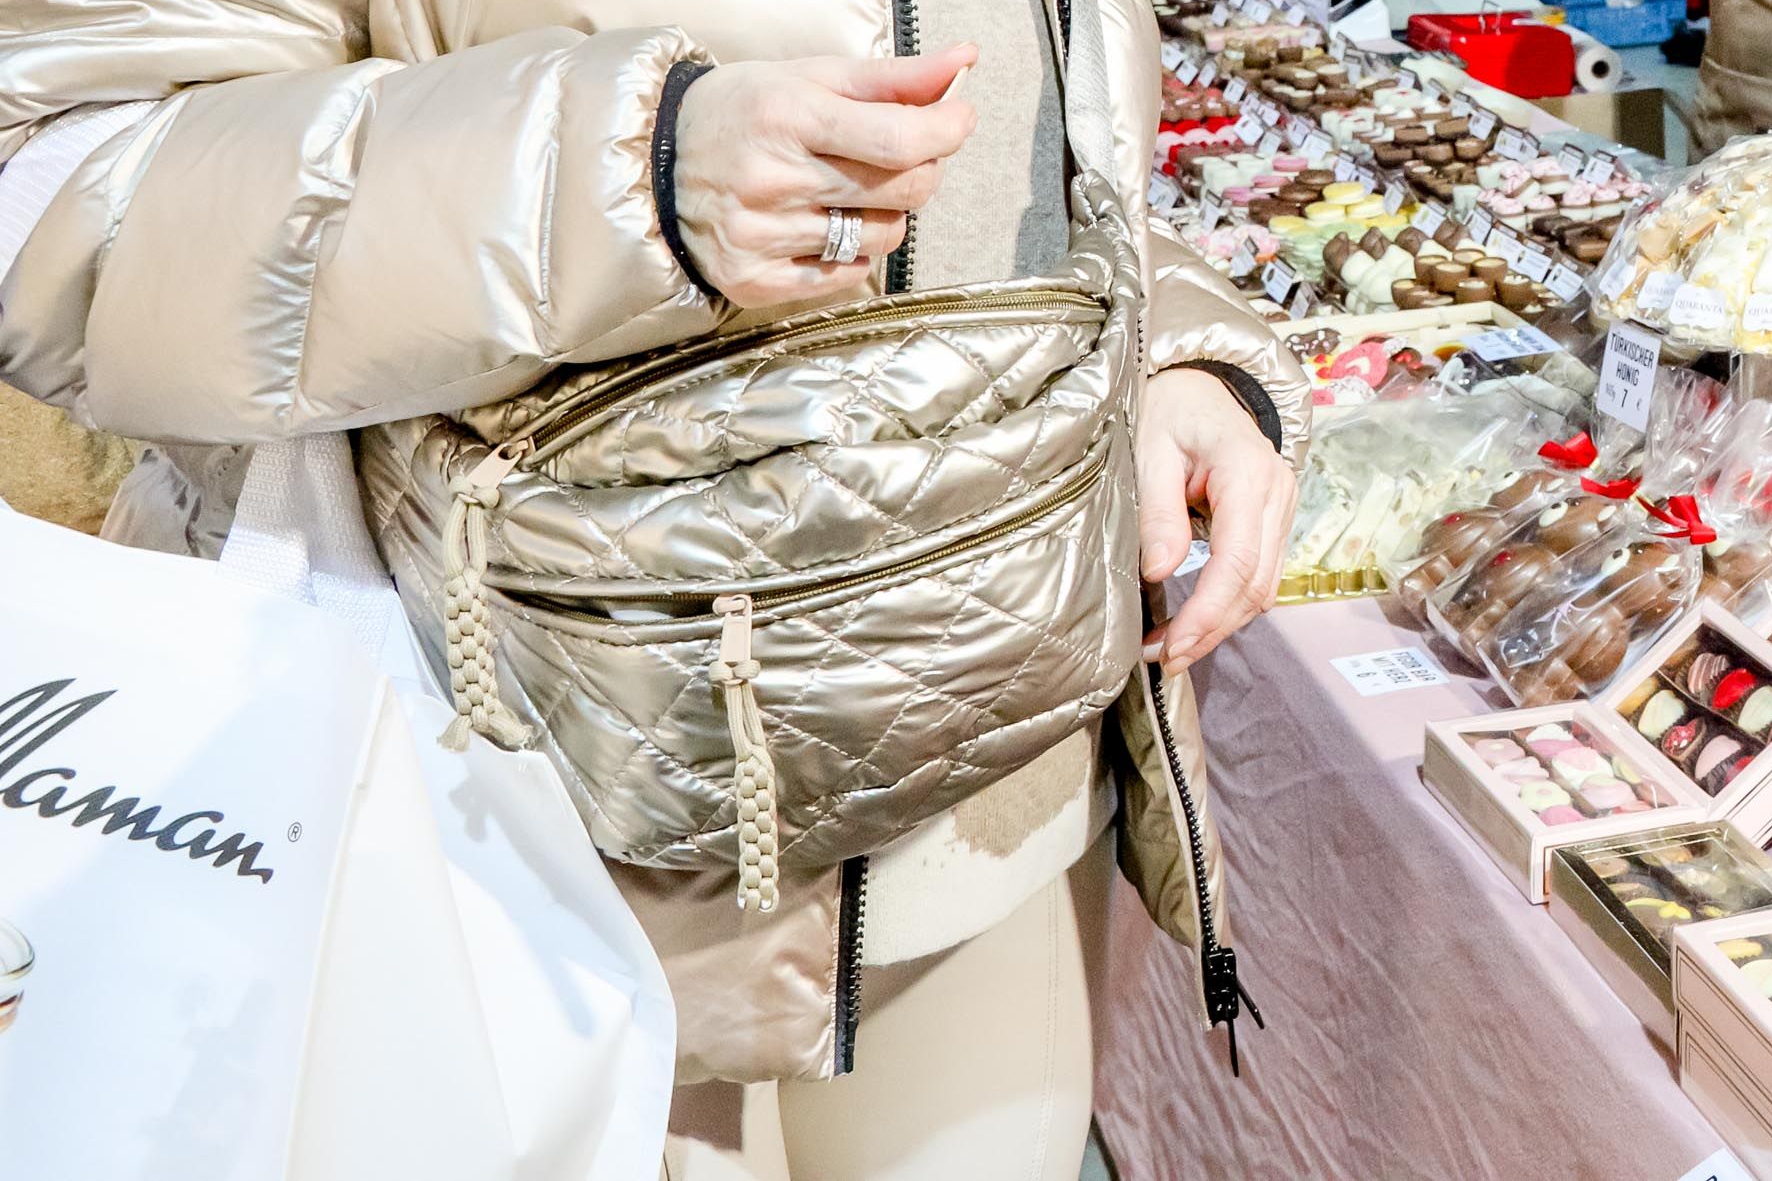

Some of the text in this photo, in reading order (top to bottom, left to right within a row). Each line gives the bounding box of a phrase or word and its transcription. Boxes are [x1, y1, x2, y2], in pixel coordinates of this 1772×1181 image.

[1610, 331, 1655, 370] TÜRKISCHER
[1616, 361, 1640, 386] HONIG
[1621, 388, 1629, 408] 7
